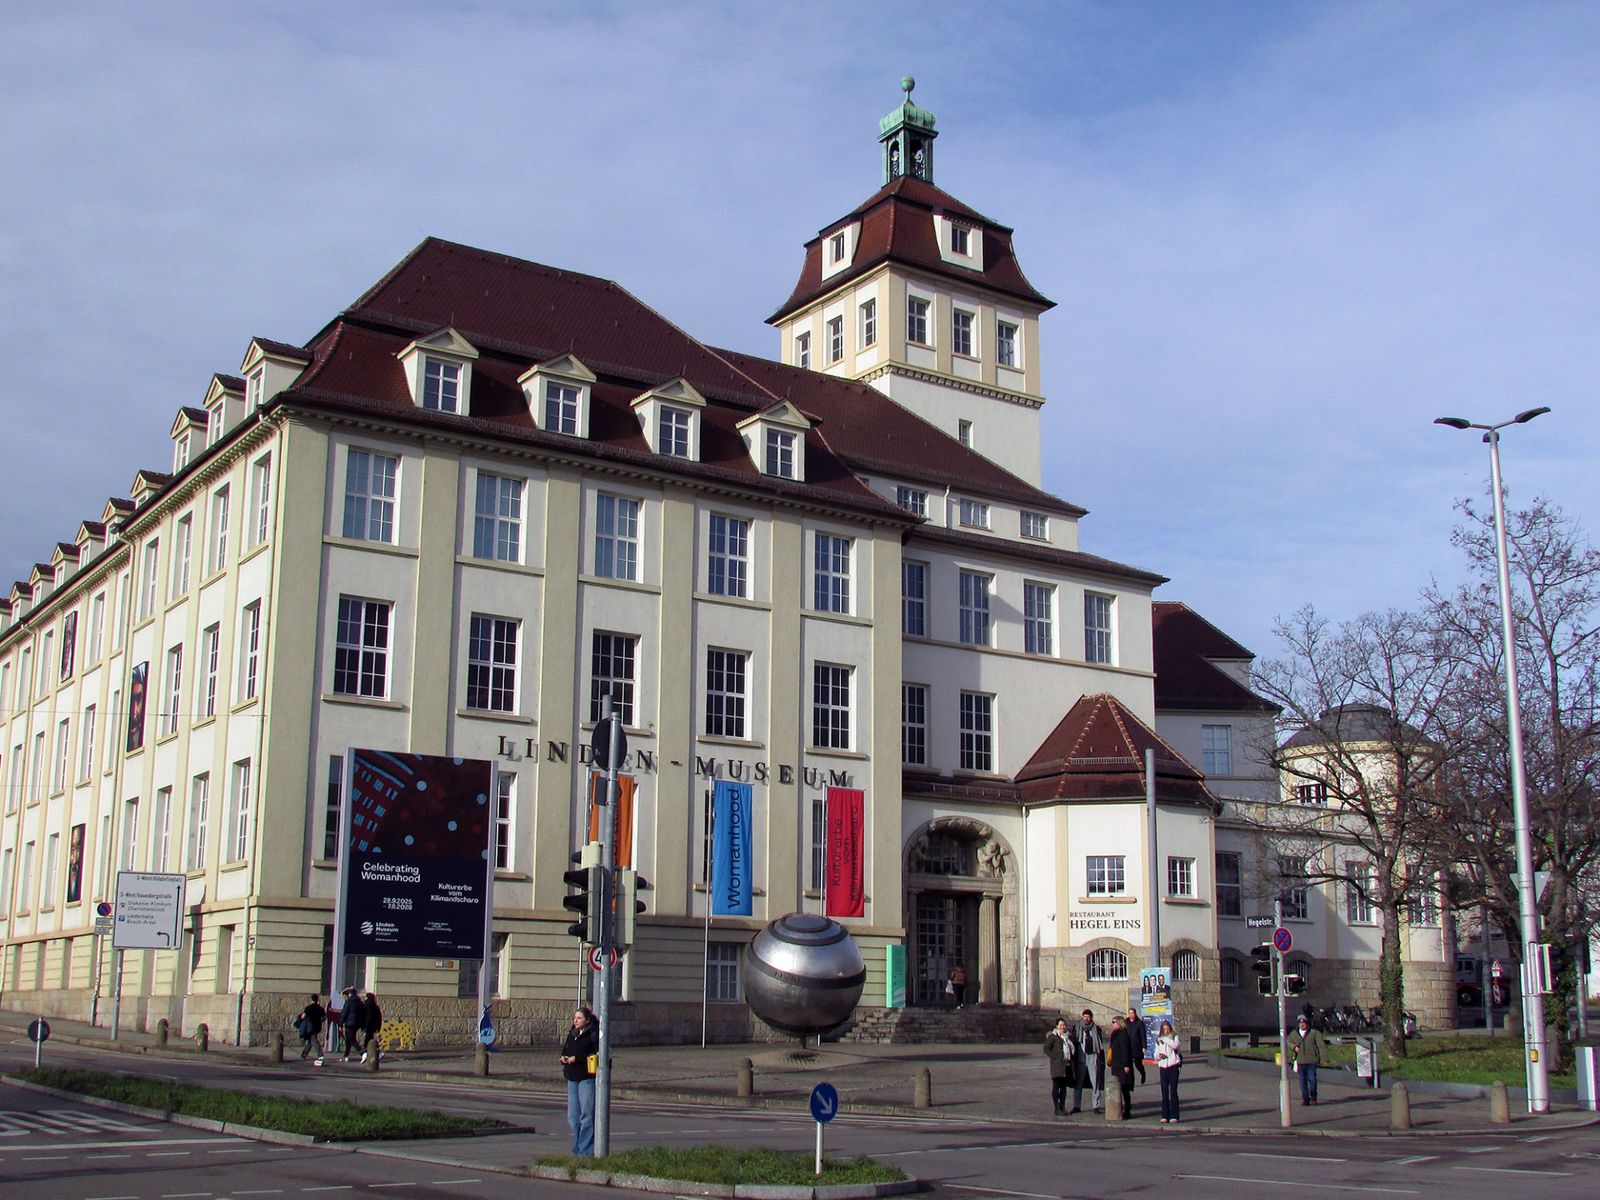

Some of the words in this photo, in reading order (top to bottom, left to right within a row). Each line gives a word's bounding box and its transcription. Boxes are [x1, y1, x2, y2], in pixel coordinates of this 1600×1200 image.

[727, 788, 741, 909] Womanhood
[832, 817, 842, 886] Kulturerbe
[363, 862, 419, 875] Celebrating
[361, 872, 421, 882] Womanhood
[438, 883, 472, 891] Kulturerbe
[430, 895, 479, 904] Kilimandscharo
[1070, 920, 1111, 929] HEGEL
[1114, 920, 1141, 929] EINS
[1248, 918, 1274, 927] Hegelstr.
